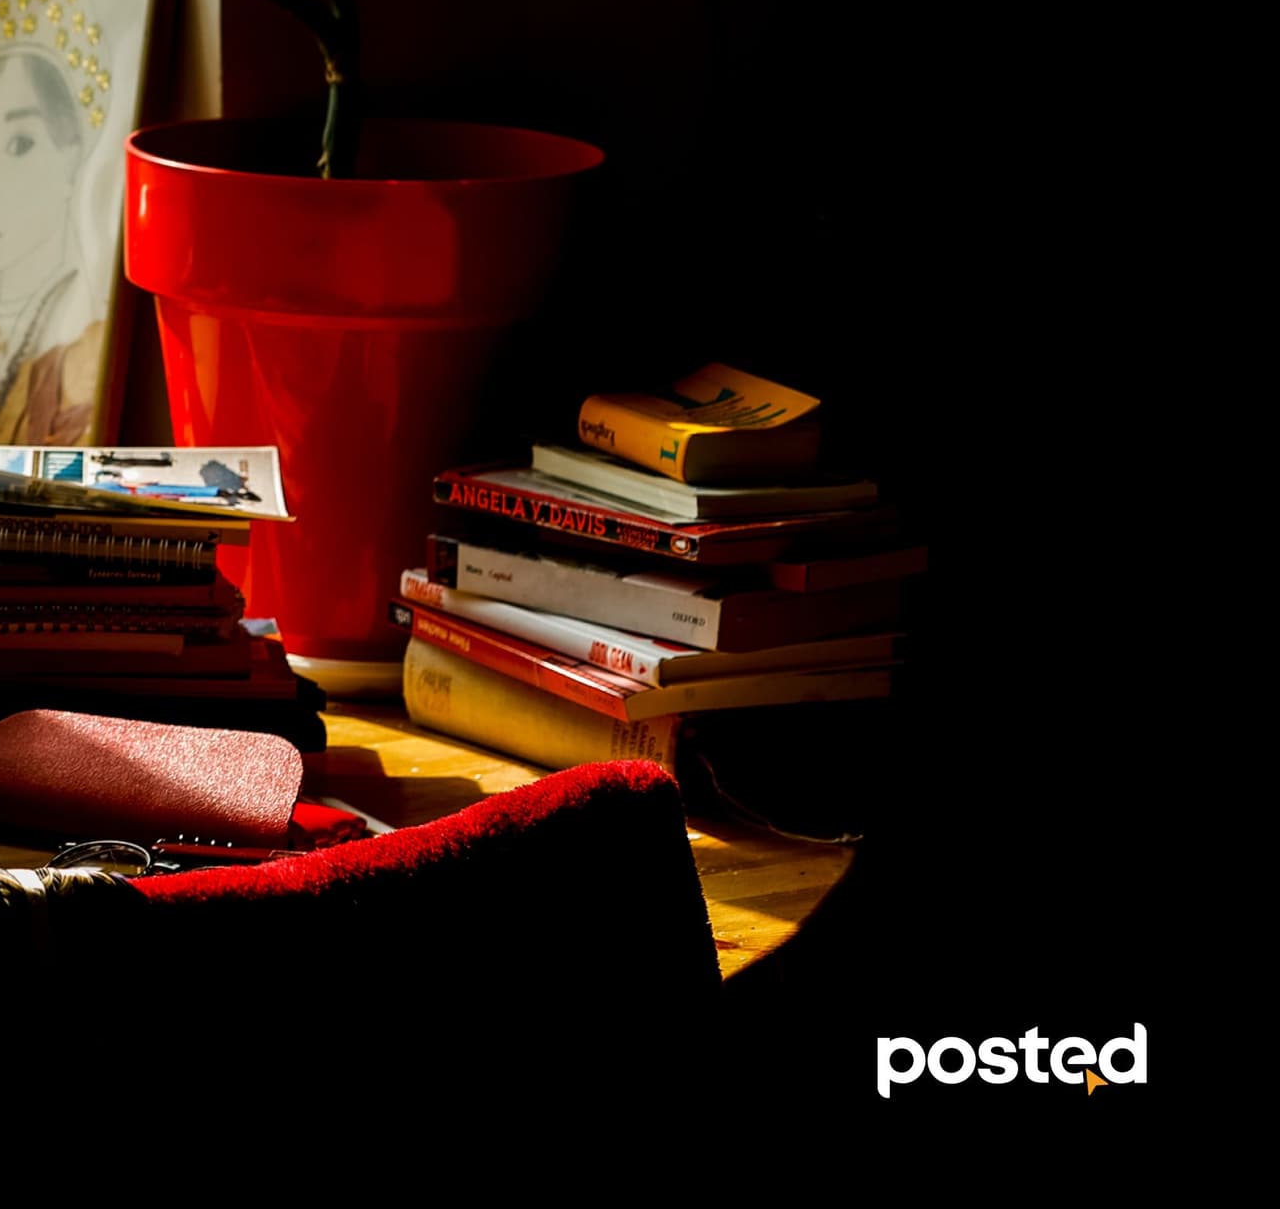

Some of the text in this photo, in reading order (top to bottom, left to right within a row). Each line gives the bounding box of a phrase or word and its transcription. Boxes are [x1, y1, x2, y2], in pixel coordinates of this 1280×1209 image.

[448, 483, 526, 519] ANGELA
[531, 501, 546, 522] Y.
[548, 505, 608, 537] DAVIS
